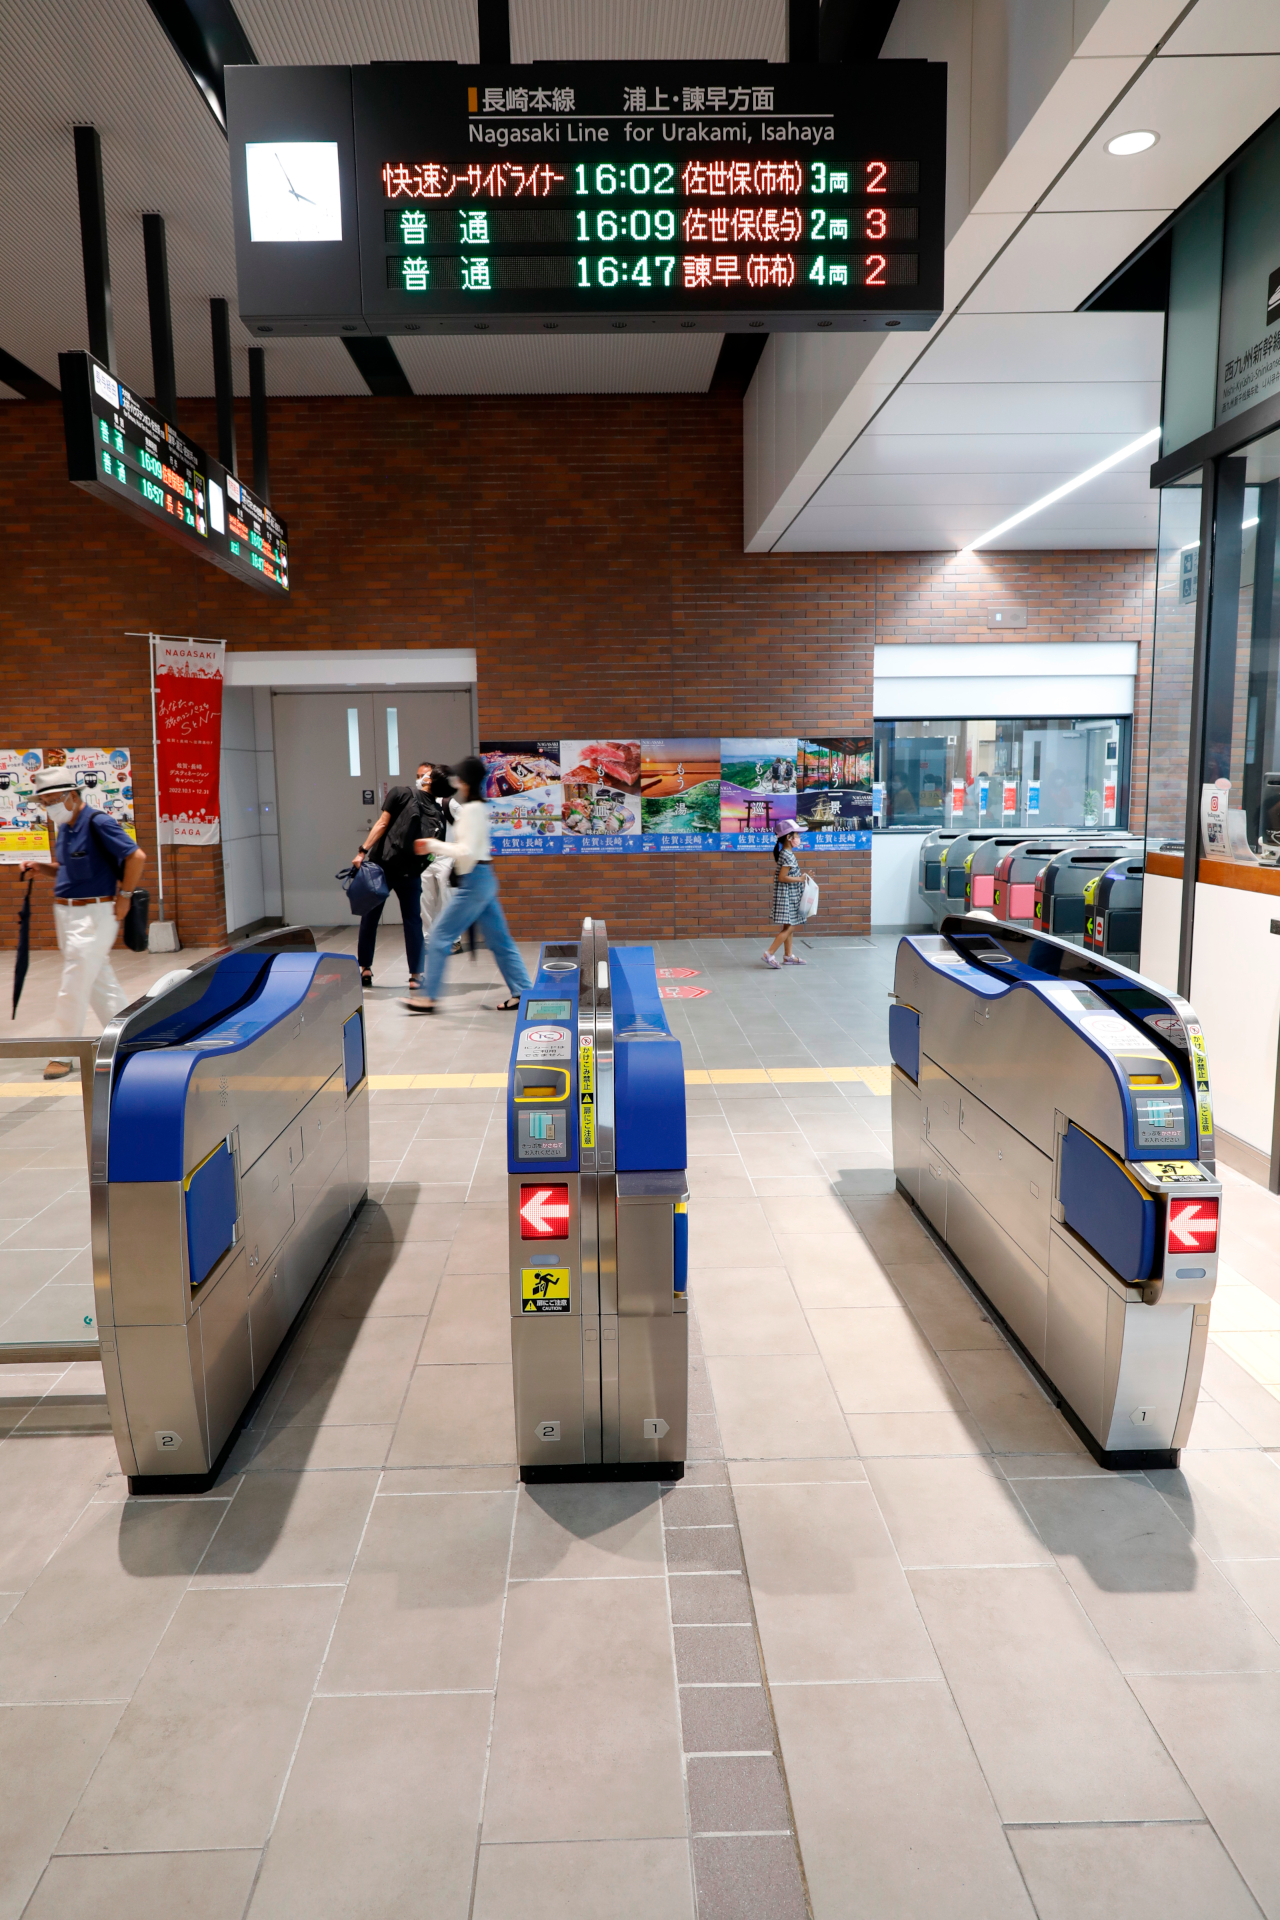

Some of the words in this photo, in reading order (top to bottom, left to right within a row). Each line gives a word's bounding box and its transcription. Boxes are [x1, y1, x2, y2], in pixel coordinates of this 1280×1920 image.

[482, 87, 576, 112] 長崎本線
[623, 86, 774, 112] 浦上・諫早方面
[468, 123, 560, 147] Nagasaki
[567, 122, 609, 142] Line
[624, 122, 655, 142] for
[661, 122, 752, 144] Urakami,
[761, 121, 835, 146] Isahaya
[382, 163, 565, 198] 快速シーサイドライナー
[575, 163, 675, 195] 16:02
[682, 161, 802, 195] 佐世保(市布)
[811, 161, 848, 194] 3両
[866, 162, 887, 193] 2
[576, 209, 675, 242] 16:09
[682, 207, 802, 242] 佐世保(長与)
[811, 209, 848, 241] 2両
[866, 208, 887, 240] 3
[577, 256, 676, 287] 16:47
[809, 255, 848, 286] 4両
[866, 255, 886, 286] 2
[140, 448, 163, 481] 16:09
[142, 478, 164, 508] 16:57
[165, 648, 216, 660] NAGASAKI
[176, 762, 203, 770] 佐賀・長崎
[169, 769, 210, 778] デスティネーション
[174, 828, 201, 836] SAGA
[502, 837, 544, 848] 佐賀と長崎
[582, 837, 623, 847] 佐賀と長崎
[661, 835, 702, 845] 佐賀と長崎
[816, 833, 856, 844] 佐賀と長崎
[583, 1047, 591, 1091] かけこみ禁止
[1142, 1411, 1147, 1422] 1
[543, 1426, 555, 1437] 2
[652, 1423, 658, 1434] 1
[162, 1435, 174, 1447] 2
